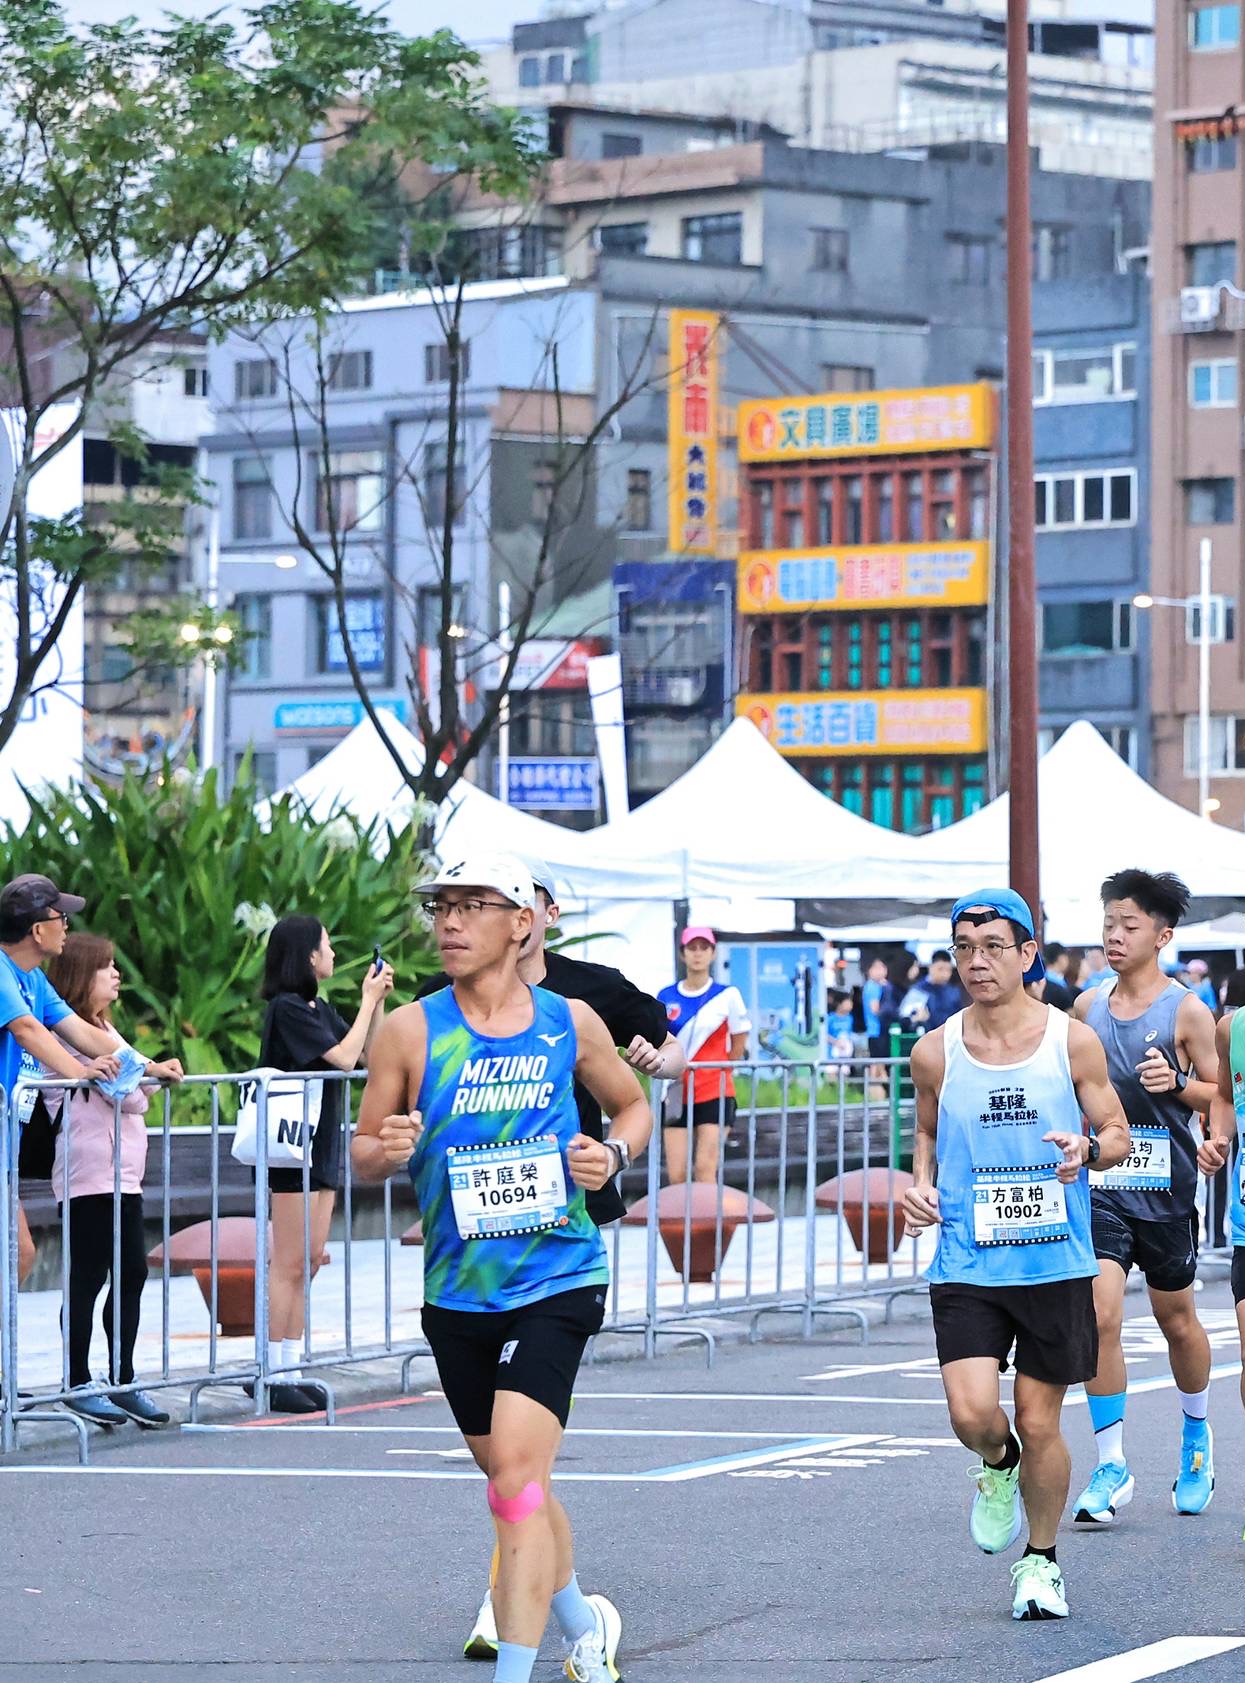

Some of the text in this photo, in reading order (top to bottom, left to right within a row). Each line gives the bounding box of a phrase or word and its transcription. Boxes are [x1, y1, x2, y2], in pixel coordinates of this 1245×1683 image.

[776, 702, 878, 746] 生活百貨
[458, 1055, 548, 1086] MIZUNO
[450, 1082, 554, 1115] RUNNING
[988, 1094, 1027, 1111] 基隆
[979, 1109, 1038, 1123] 半程馬拉松
[452, 1174, 466, 1183] 21
[472, 1162, 539, 1188] 許庭榮
[478, 1185, 538, 1207] 10694
[975, 1191, 987, 1199] 21
[992, 1185, 1044, 1203] 方富柏
[995, 1204, 1042, 1219] 10902
